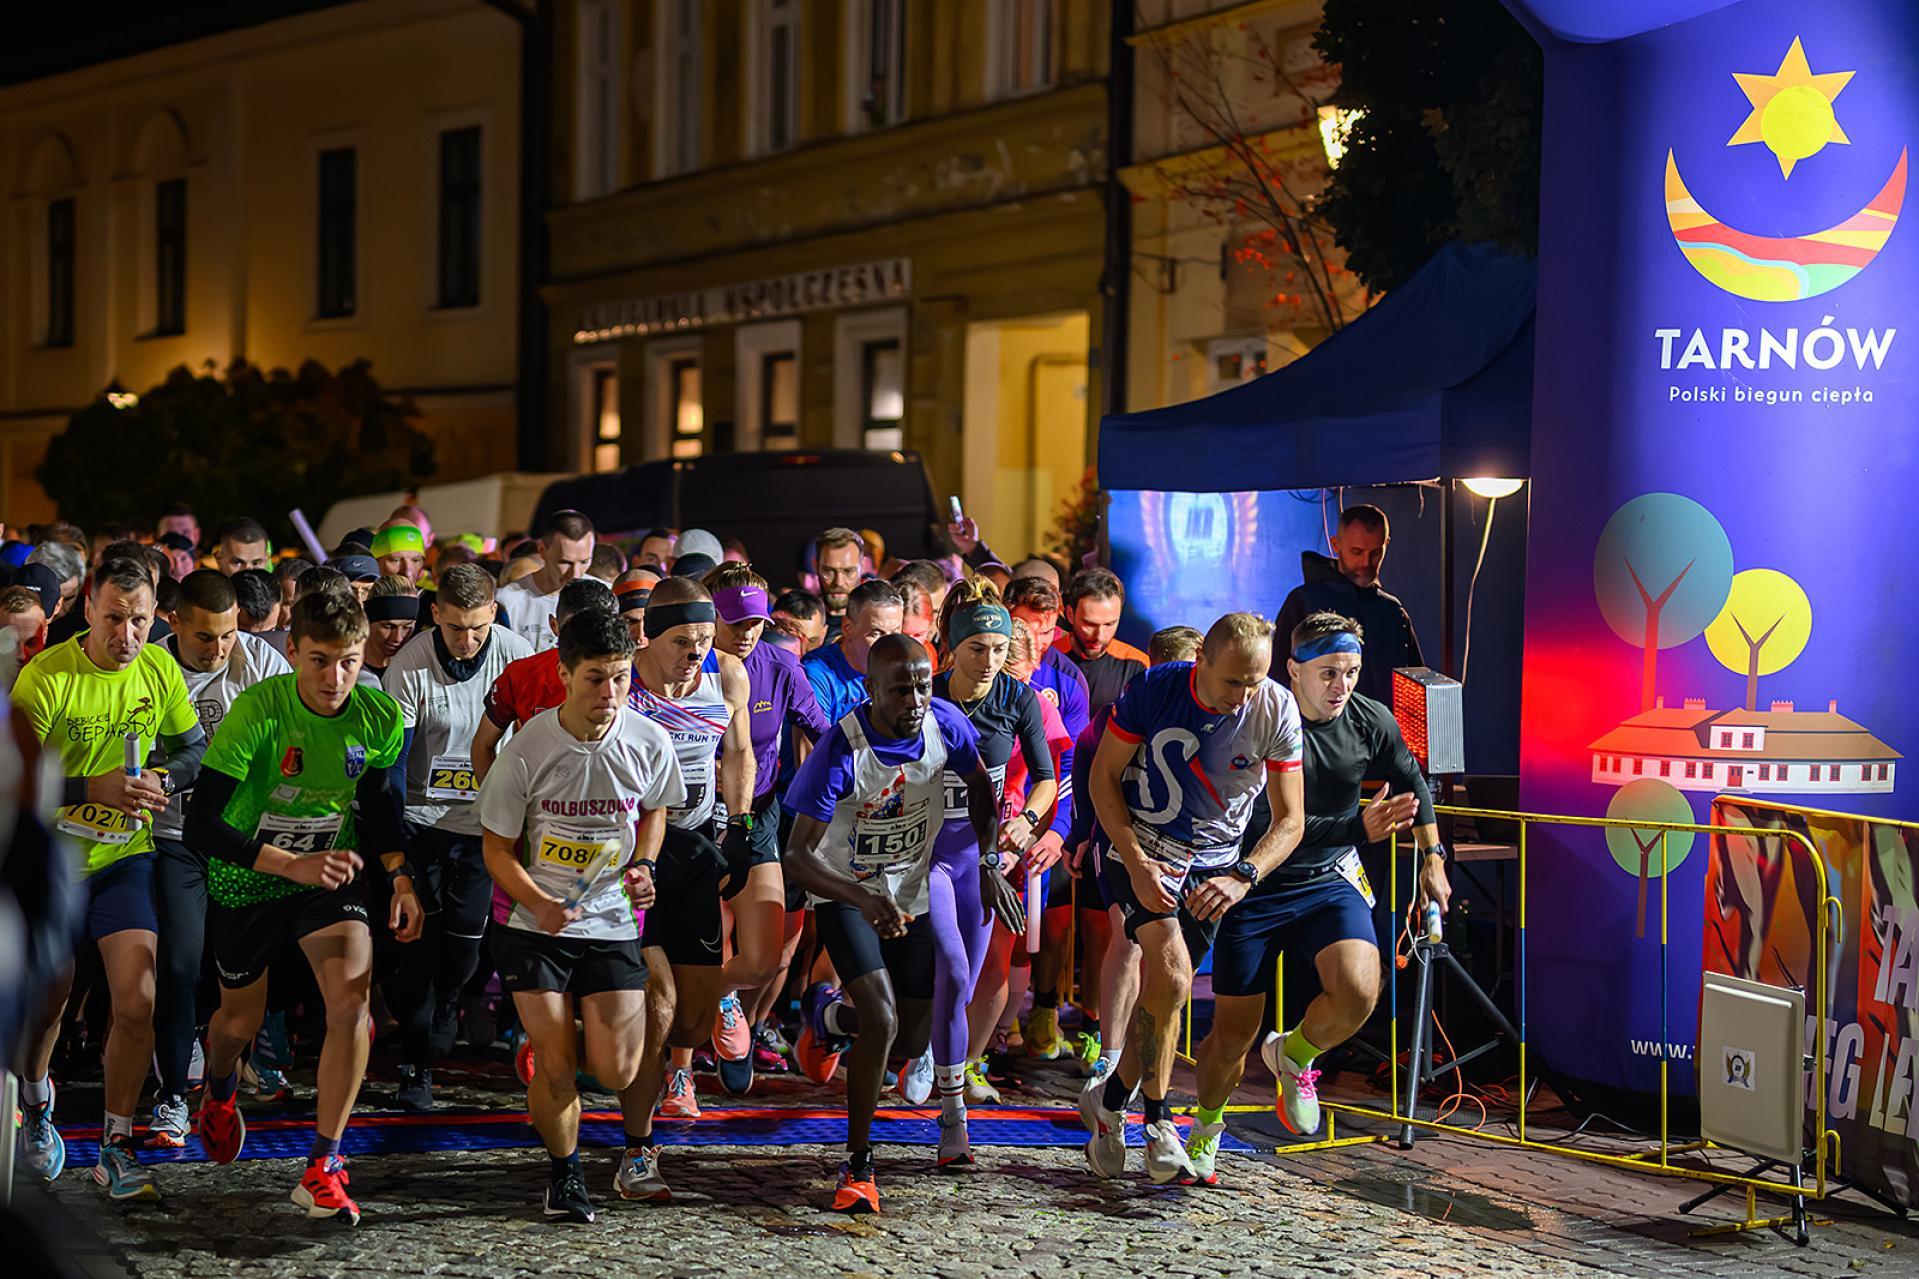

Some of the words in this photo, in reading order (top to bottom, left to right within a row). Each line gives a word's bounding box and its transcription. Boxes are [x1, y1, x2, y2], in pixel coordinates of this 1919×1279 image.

[1654, 315, 1897, 371] TARNÓW
[1669, 386, 1726, 402] Polski
[1734, 386, 1802, 404] biegun
[1811, 386, 1873, 404] ciepła
[688, 733, 709, 742] RUN
[272, 832, 316, 852] 64
[865, 826, 920, 854] 150
[544, 841, 601, 865] 708/
